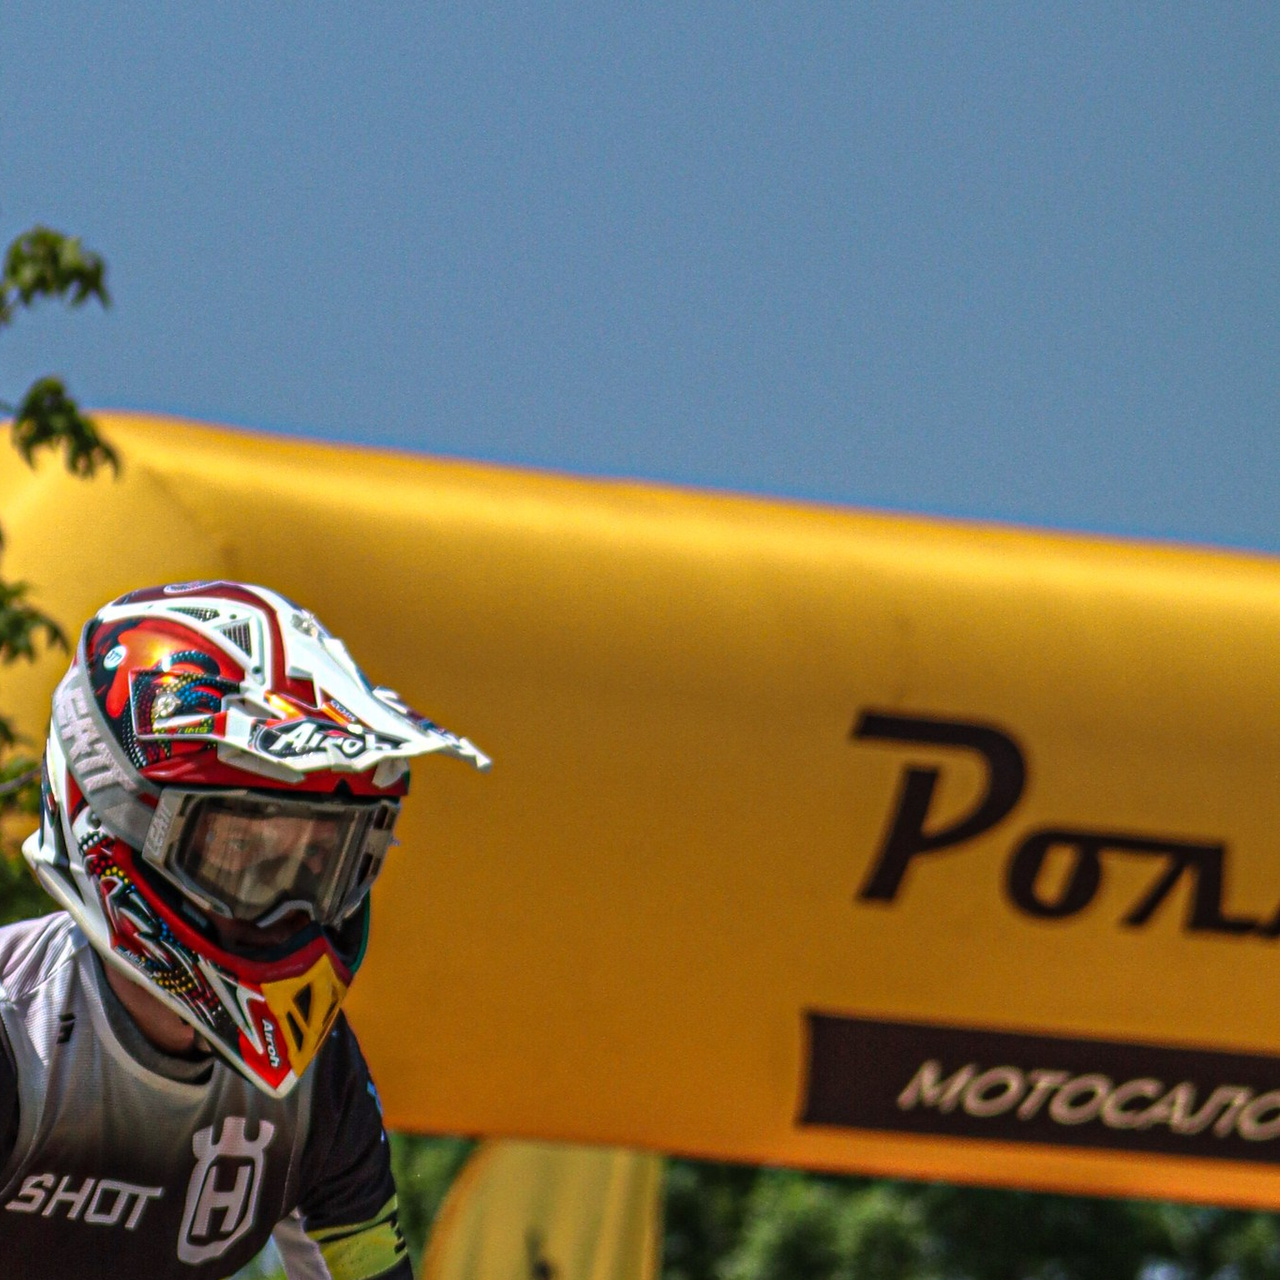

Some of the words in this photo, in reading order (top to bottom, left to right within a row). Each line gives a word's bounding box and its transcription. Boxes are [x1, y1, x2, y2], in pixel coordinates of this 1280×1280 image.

[849, 706, 1280, 942] Рол
[261, 1018, 282, 1068] Airoh
[6, 1173, 162, 1230] SHOT
